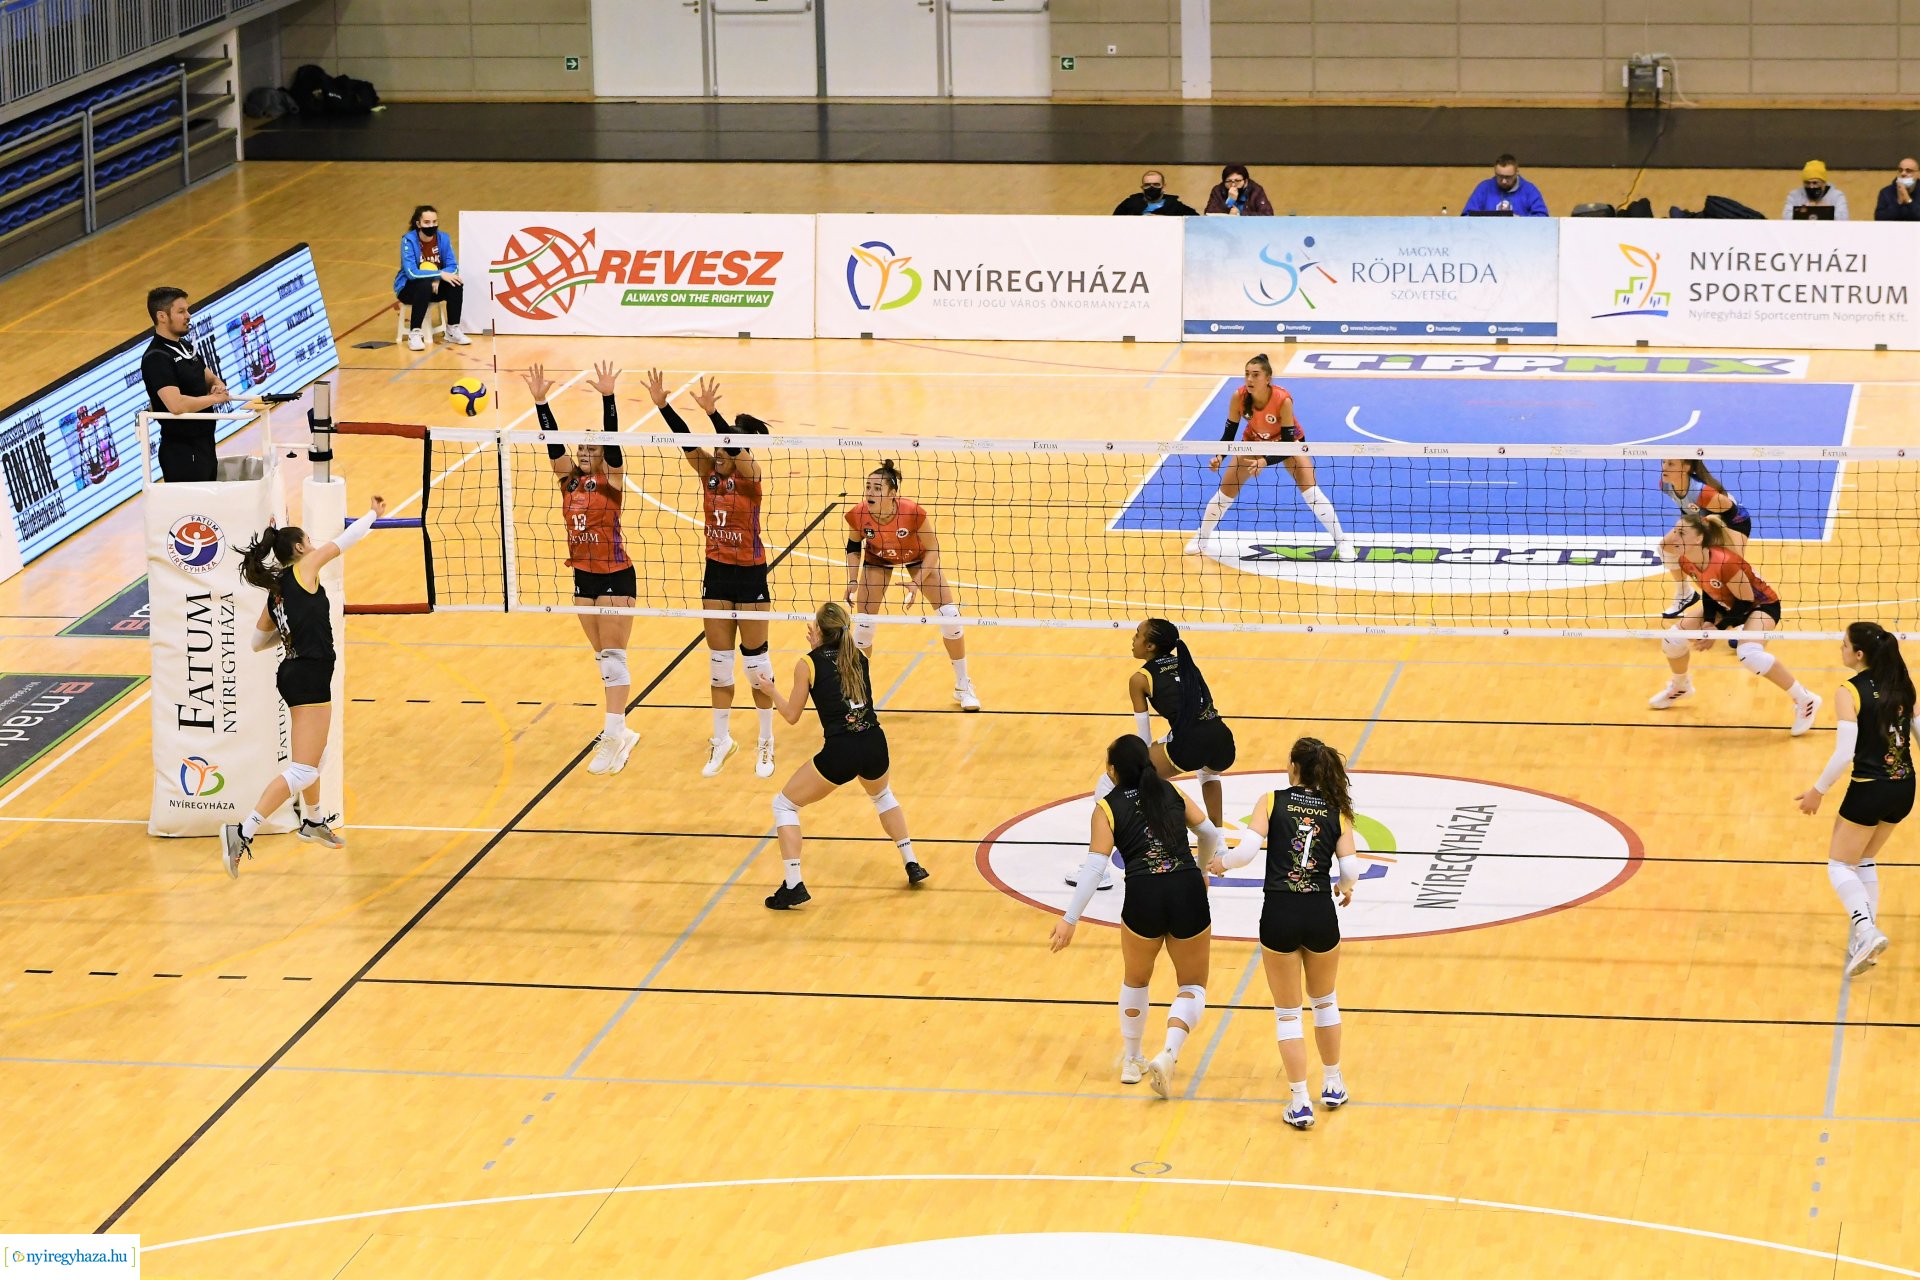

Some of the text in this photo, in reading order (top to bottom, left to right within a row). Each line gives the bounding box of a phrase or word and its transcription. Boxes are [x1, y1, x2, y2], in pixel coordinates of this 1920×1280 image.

[1398, 246, 1449, 258] MAGYAR
[1690, 247, 1867, 272] NYÍREGYHÁZI
[933, 263, 1150, 294] NYÍREGYHÁZA
[1352, 258, 1498, 284] RÖPLABDA
[626, 293, 770, 304] ALWAYS ON THE RIGHT WAY
[932, 298, 973, 308] MEGYEI
[1011, 298, 1046, 309] VÁROS
[1050, 298, 1150, 309] ÖNKORMÁNYZATA
[1689, 282, 1909, 305] SPORTCENTRUM
[1688, 309, 1908, 323] Nyíregyházi Sportcentrum Nonprofit Kft.
[2, 432, 59, 513] ONLINE
[190, 516, 219, 532] FATUM
[174, 590, 215, 734] FATUM
[217, 591, 237, 734] NYÍREGYHÁZA
[169, 799, 235, 810] NYÍREGYHÁZA
[1298, 824, 1314, 868] 7
[1411, 804, 1497, 909] NYÍREGYHÁZA
